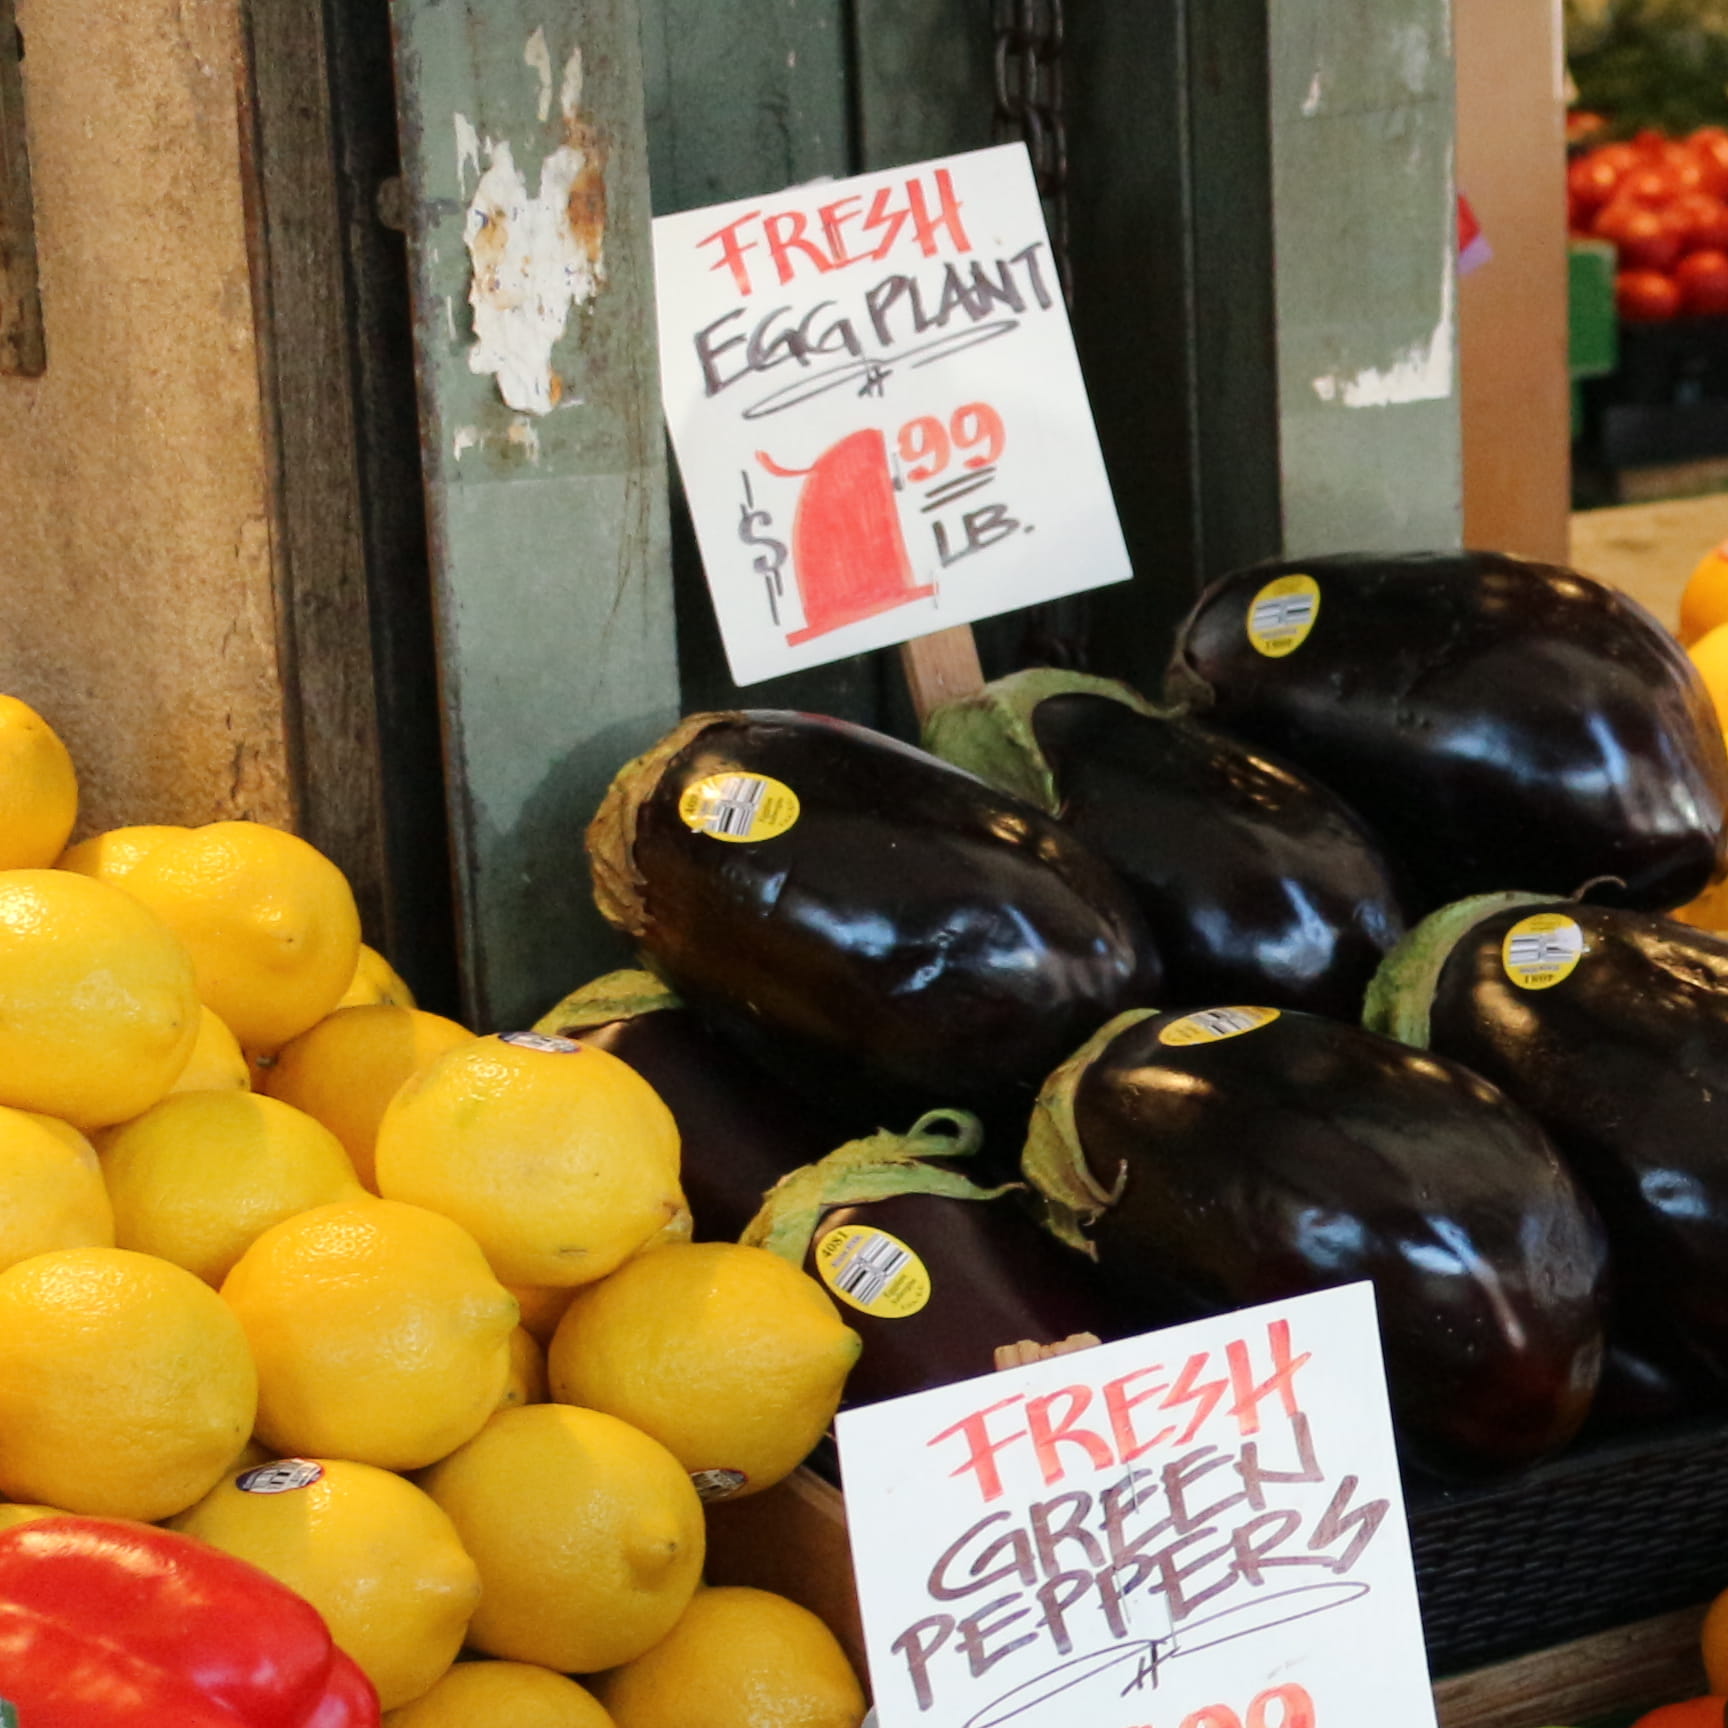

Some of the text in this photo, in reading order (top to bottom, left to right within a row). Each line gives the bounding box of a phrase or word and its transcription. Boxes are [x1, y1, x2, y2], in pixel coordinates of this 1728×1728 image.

[697, 167, 973, 297] FRESH
[738, 401, 1007, 647] $1.99
[931, 503, 1036, 567] LB.
[925, 1317, 1314, 1504] FRESH
[888, 1473, 1393, 1713] PEPPERS
[925, 1410, 1325, 1600] GREEN
